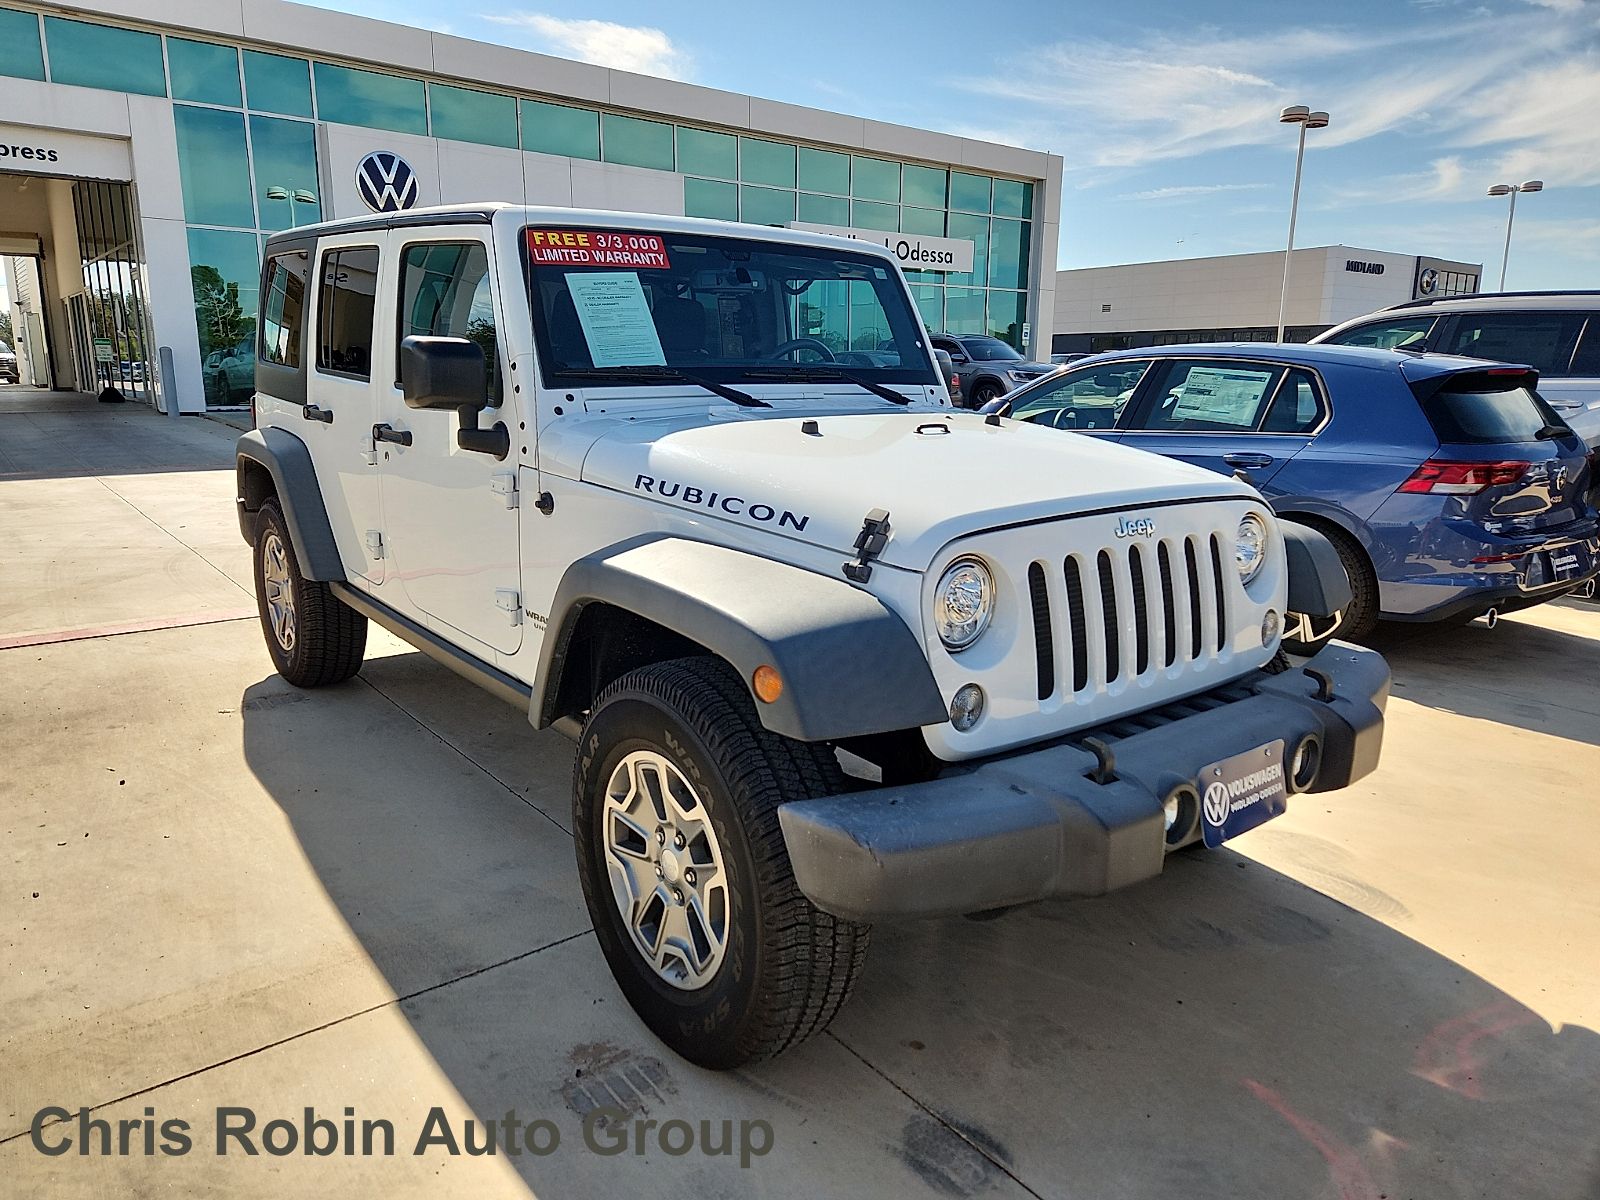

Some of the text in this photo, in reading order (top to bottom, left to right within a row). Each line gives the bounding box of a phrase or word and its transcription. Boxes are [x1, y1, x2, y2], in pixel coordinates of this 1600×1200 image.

[533, 231, 659, 251] FREE 3/3,000
[533, 248, 664, 266] LIMITED WARRANTY
[1345, 260, 1385, 275] MIDLAND
[634, 474, 810, 532] RUBICON
[1114, 516, 1156, 539] Jeep
[1227, 762, 1282, 798] VOLKSWAGEN
[1230, 782, 1283, 813] MIDLAND ODESSA
